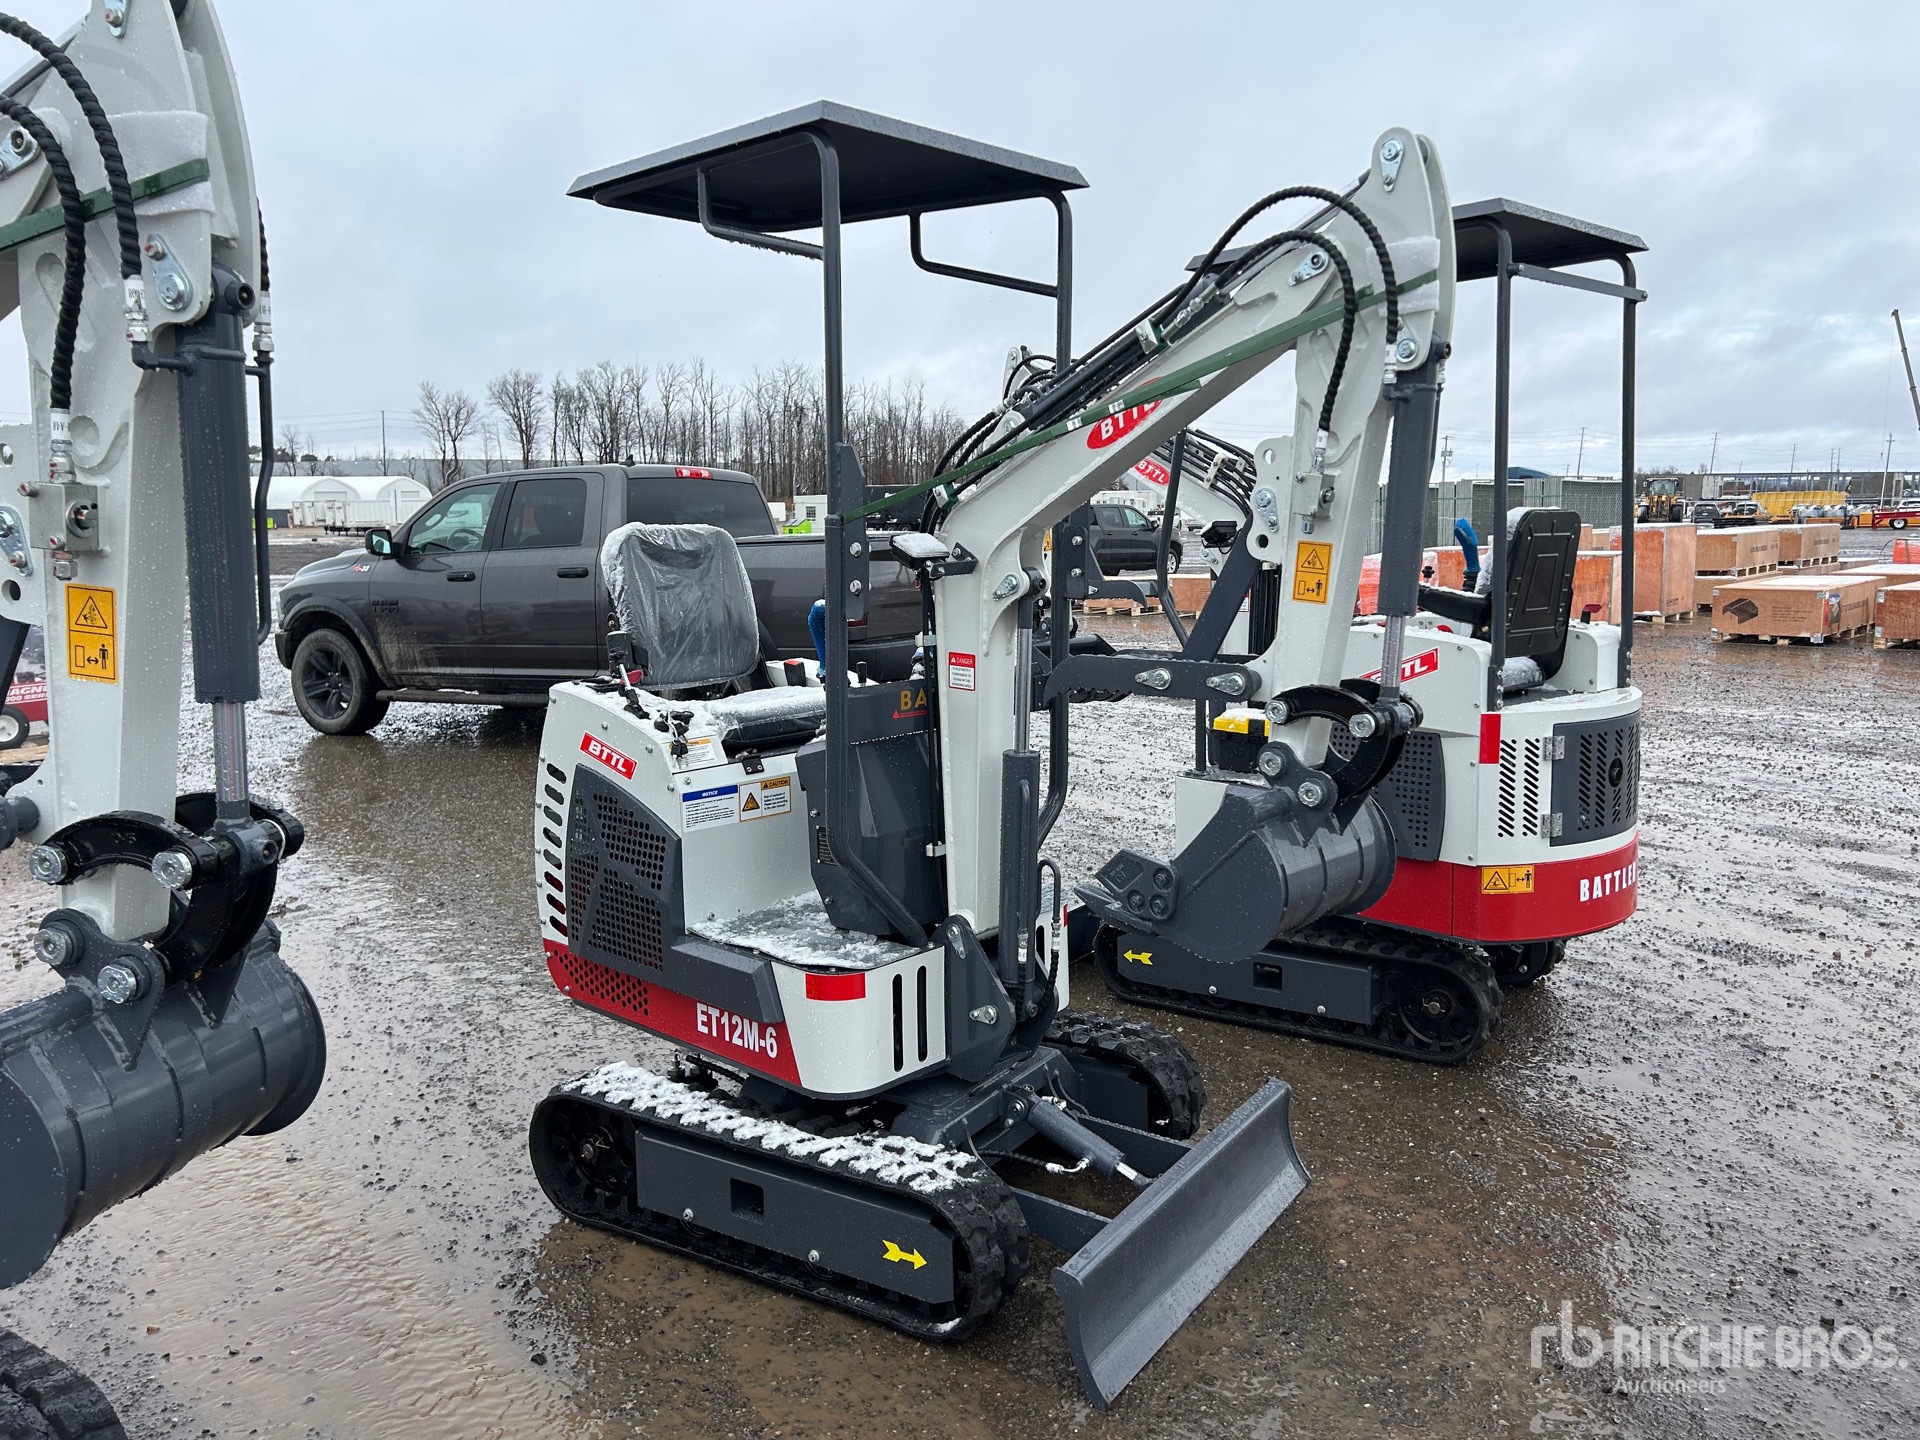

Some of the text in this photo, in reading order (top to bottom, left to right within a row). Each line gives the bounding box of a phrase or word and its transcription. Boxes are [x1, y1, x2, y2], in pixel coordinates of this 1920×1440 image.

[1138, 460, 1165, 483] BTTL
[588, 739, 627, 773] BTTL
[768, 779, 789, 788] CAUTION
[696, 1002, 778, 1059] ET12M-6
